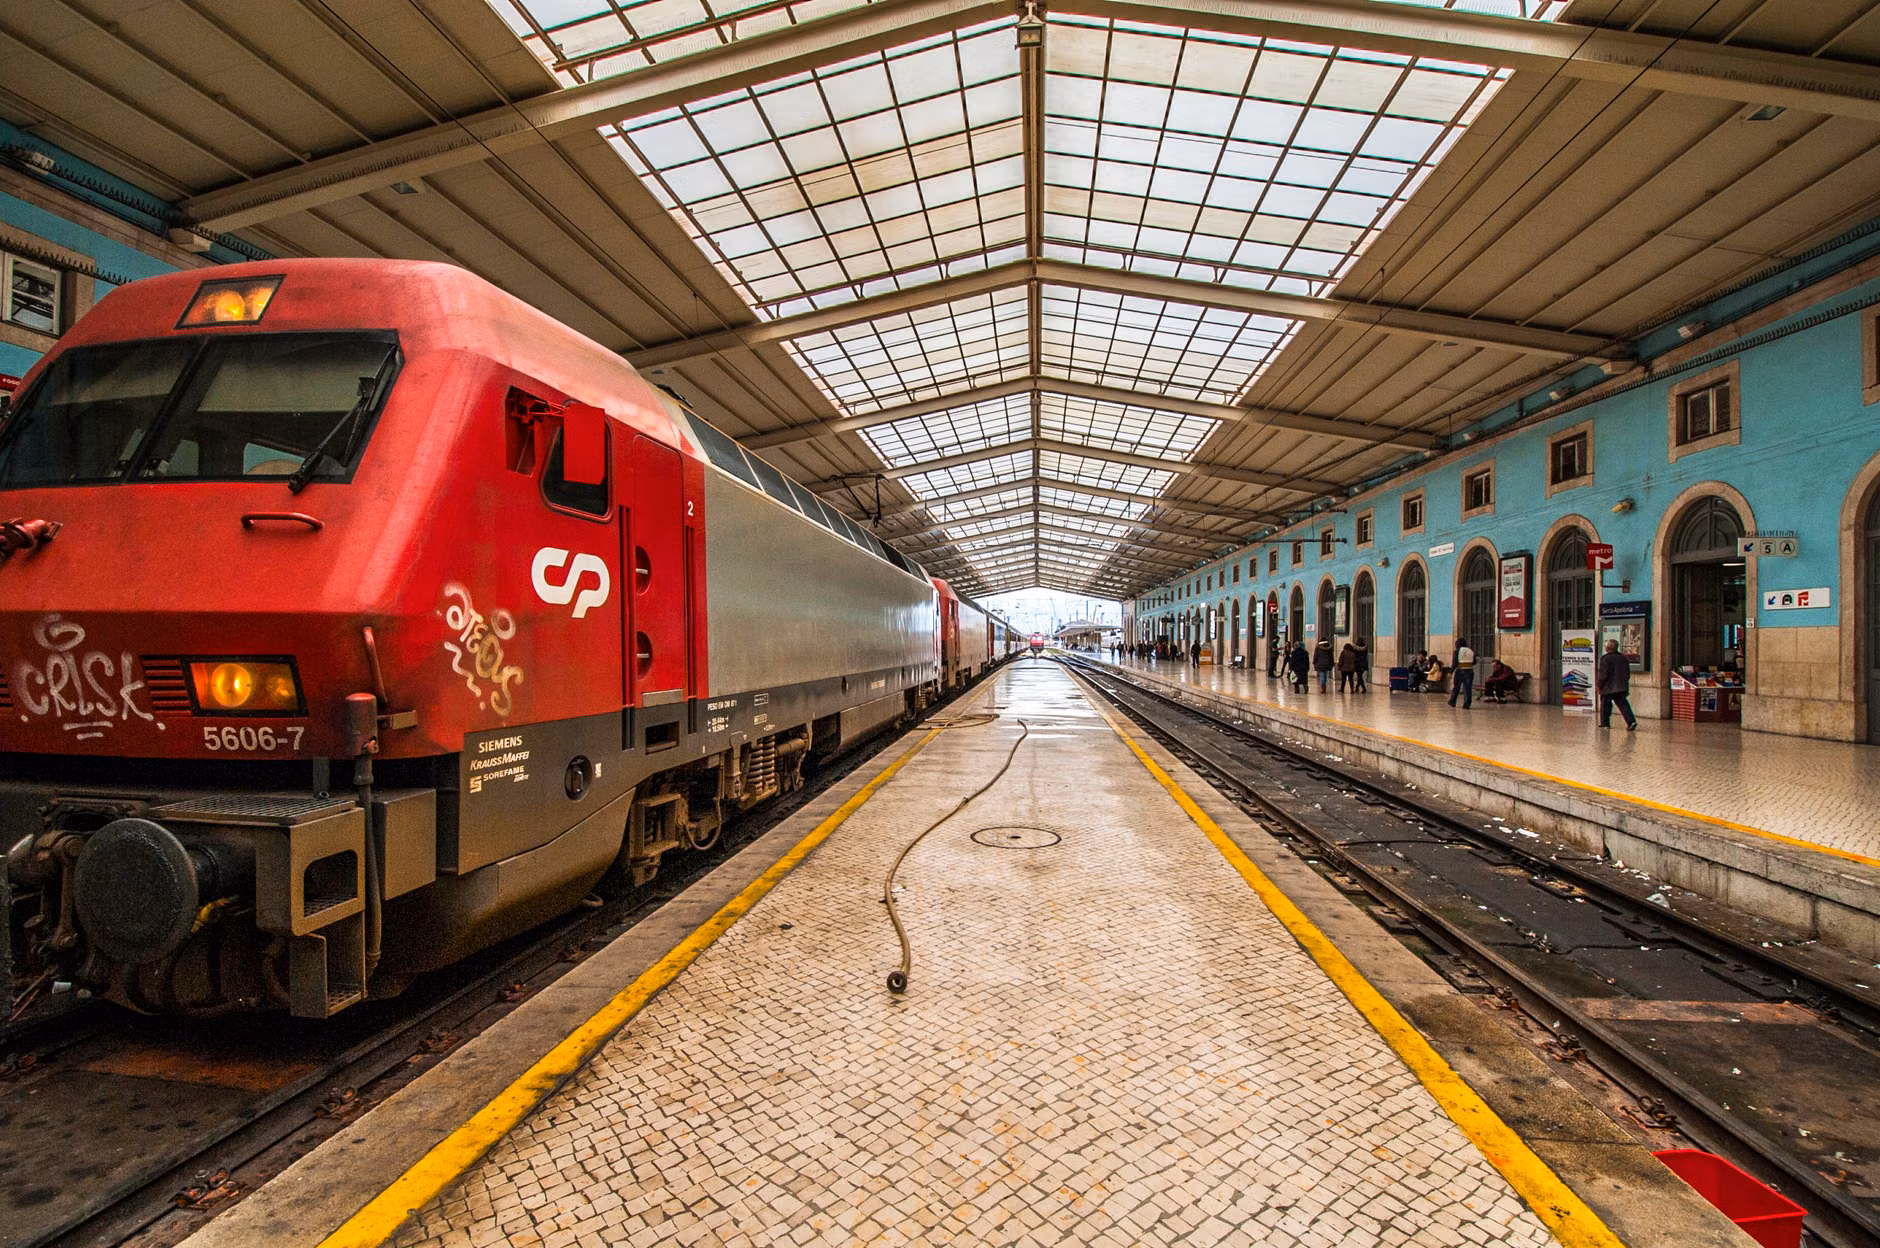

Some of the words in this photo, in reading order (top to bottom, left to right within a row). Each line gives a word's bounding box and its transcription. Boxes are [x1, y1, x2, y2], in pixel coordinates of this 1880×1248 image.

[687, 500, 694, 516] 2
[1764, 545, 1771, 554] 5
[1783, 543, 1792, 552] A
[203, 726, 305, 751] 5606-7
[478, 735, 523, 754] SIEMENS
[483, 765, 525, 782] SOREFAME
